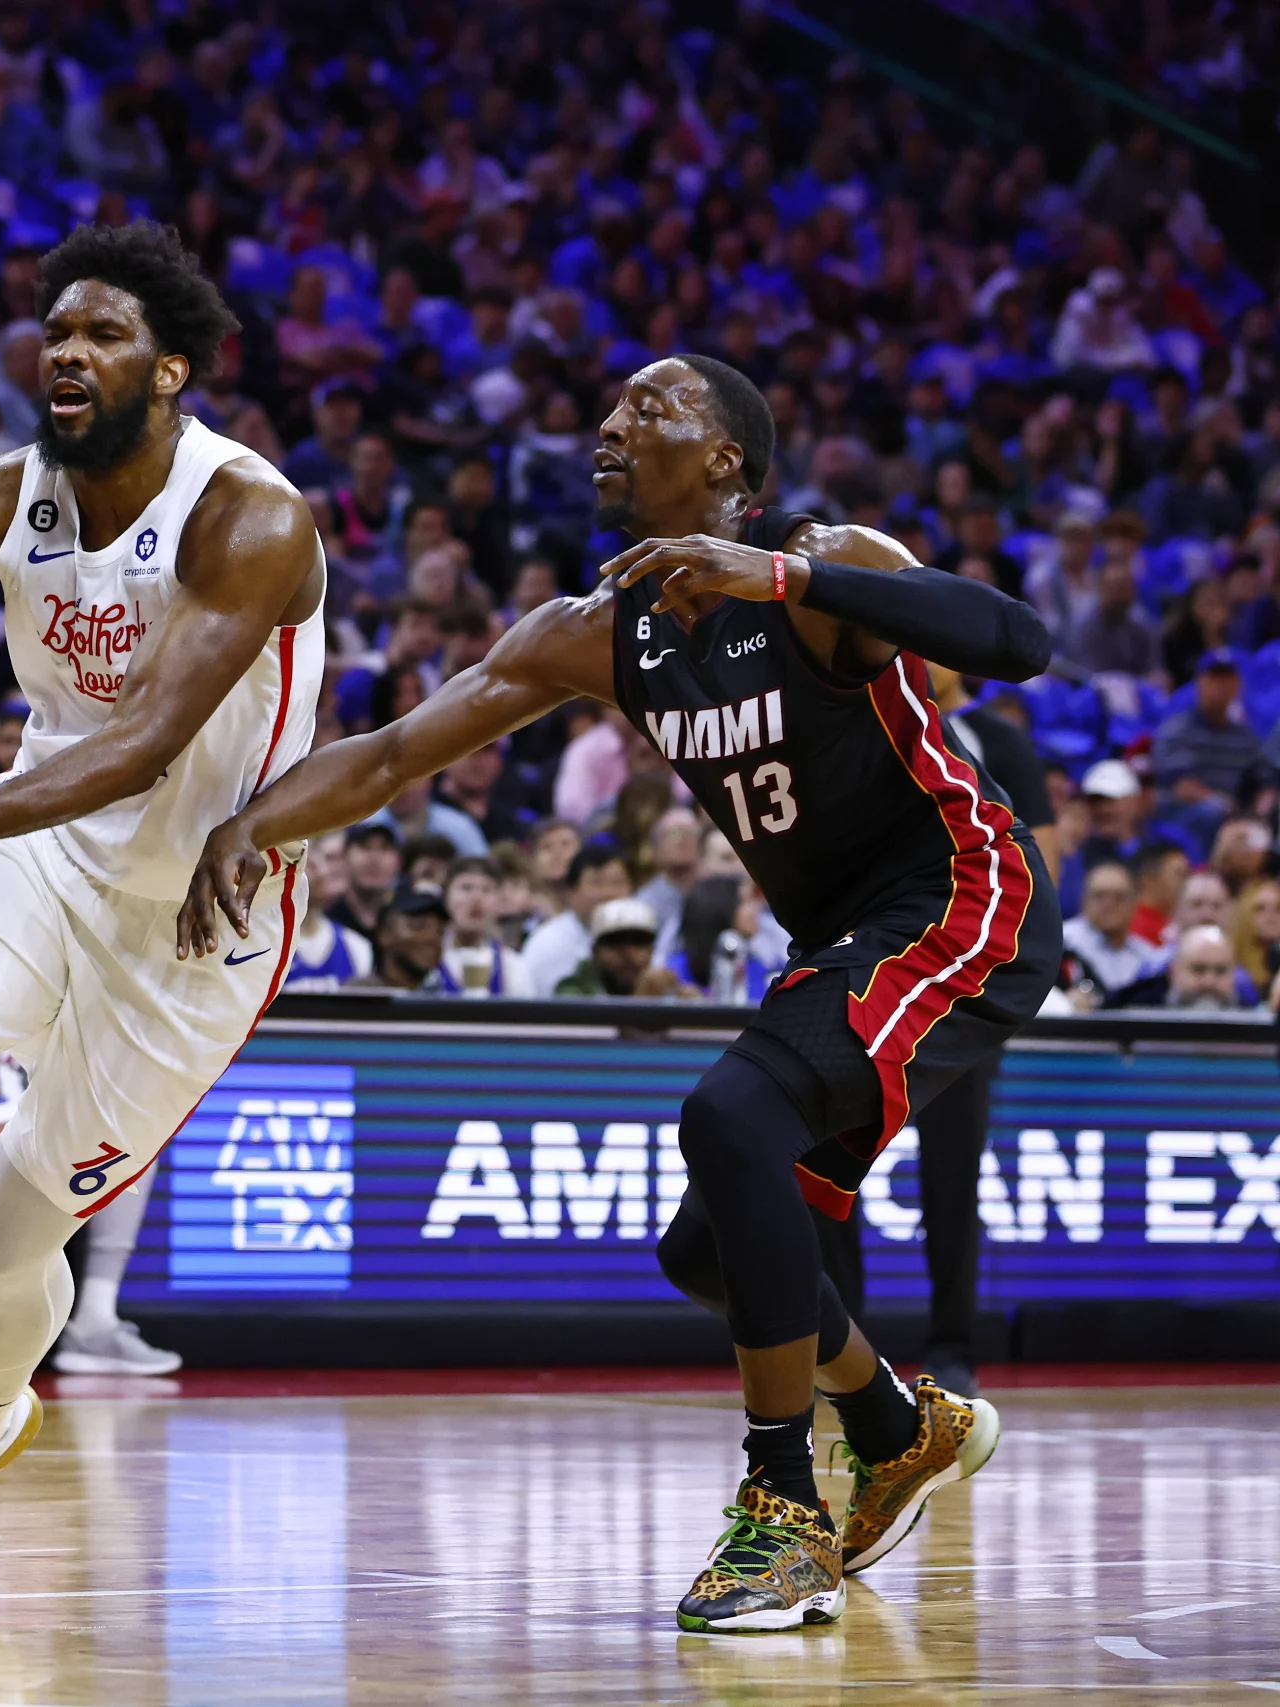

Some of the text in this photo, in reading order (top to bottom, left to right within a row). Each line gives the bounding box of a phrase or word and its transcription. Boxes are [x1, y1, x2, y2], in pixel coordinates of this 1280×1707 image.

[36, 504, 54, 528] 6
[124, 567, 161, 577] crypto.com
[637, 616, 651, 640] 6
[644, 688, 784, 760] MIAMI
[723, 760, 798, 842] 13
[69, 1141, 131, 1195] 76
